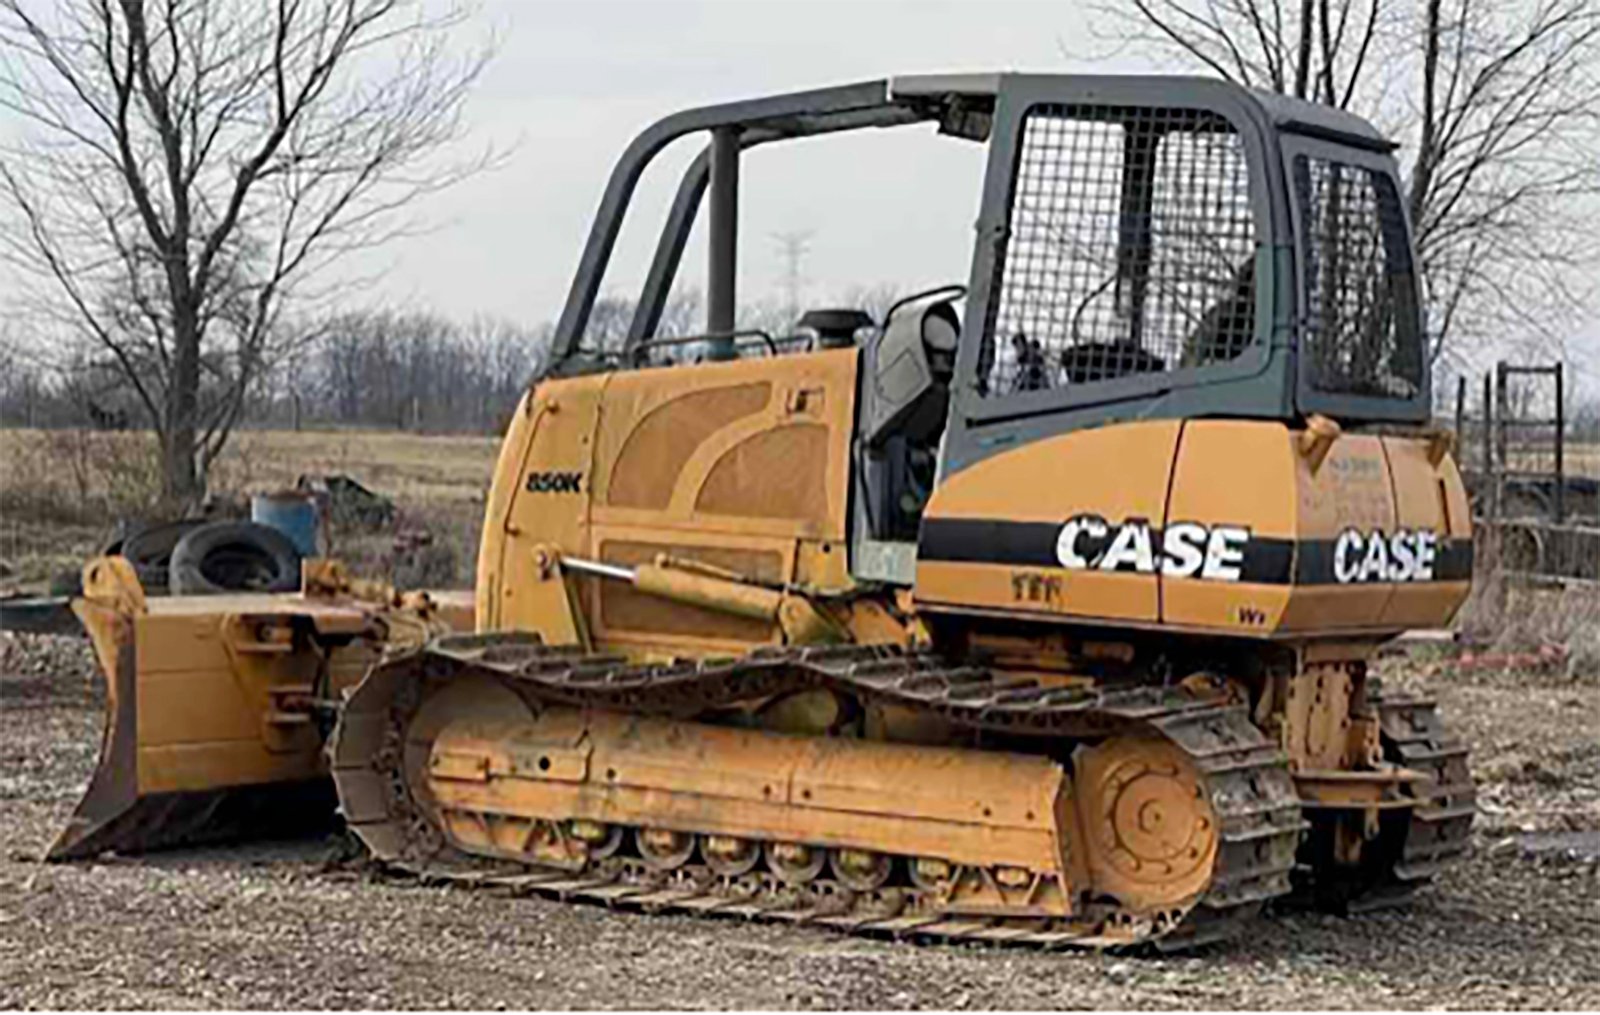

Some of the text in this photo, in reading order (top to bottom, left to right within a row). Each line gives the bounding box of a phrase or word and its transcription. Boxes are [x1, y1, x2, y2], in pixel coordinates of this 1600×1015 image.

[526, 471, 583, 492] 850K
[1056, 517, 1249, 581] CASE
[1334, 528, 1437, 582] CASE
